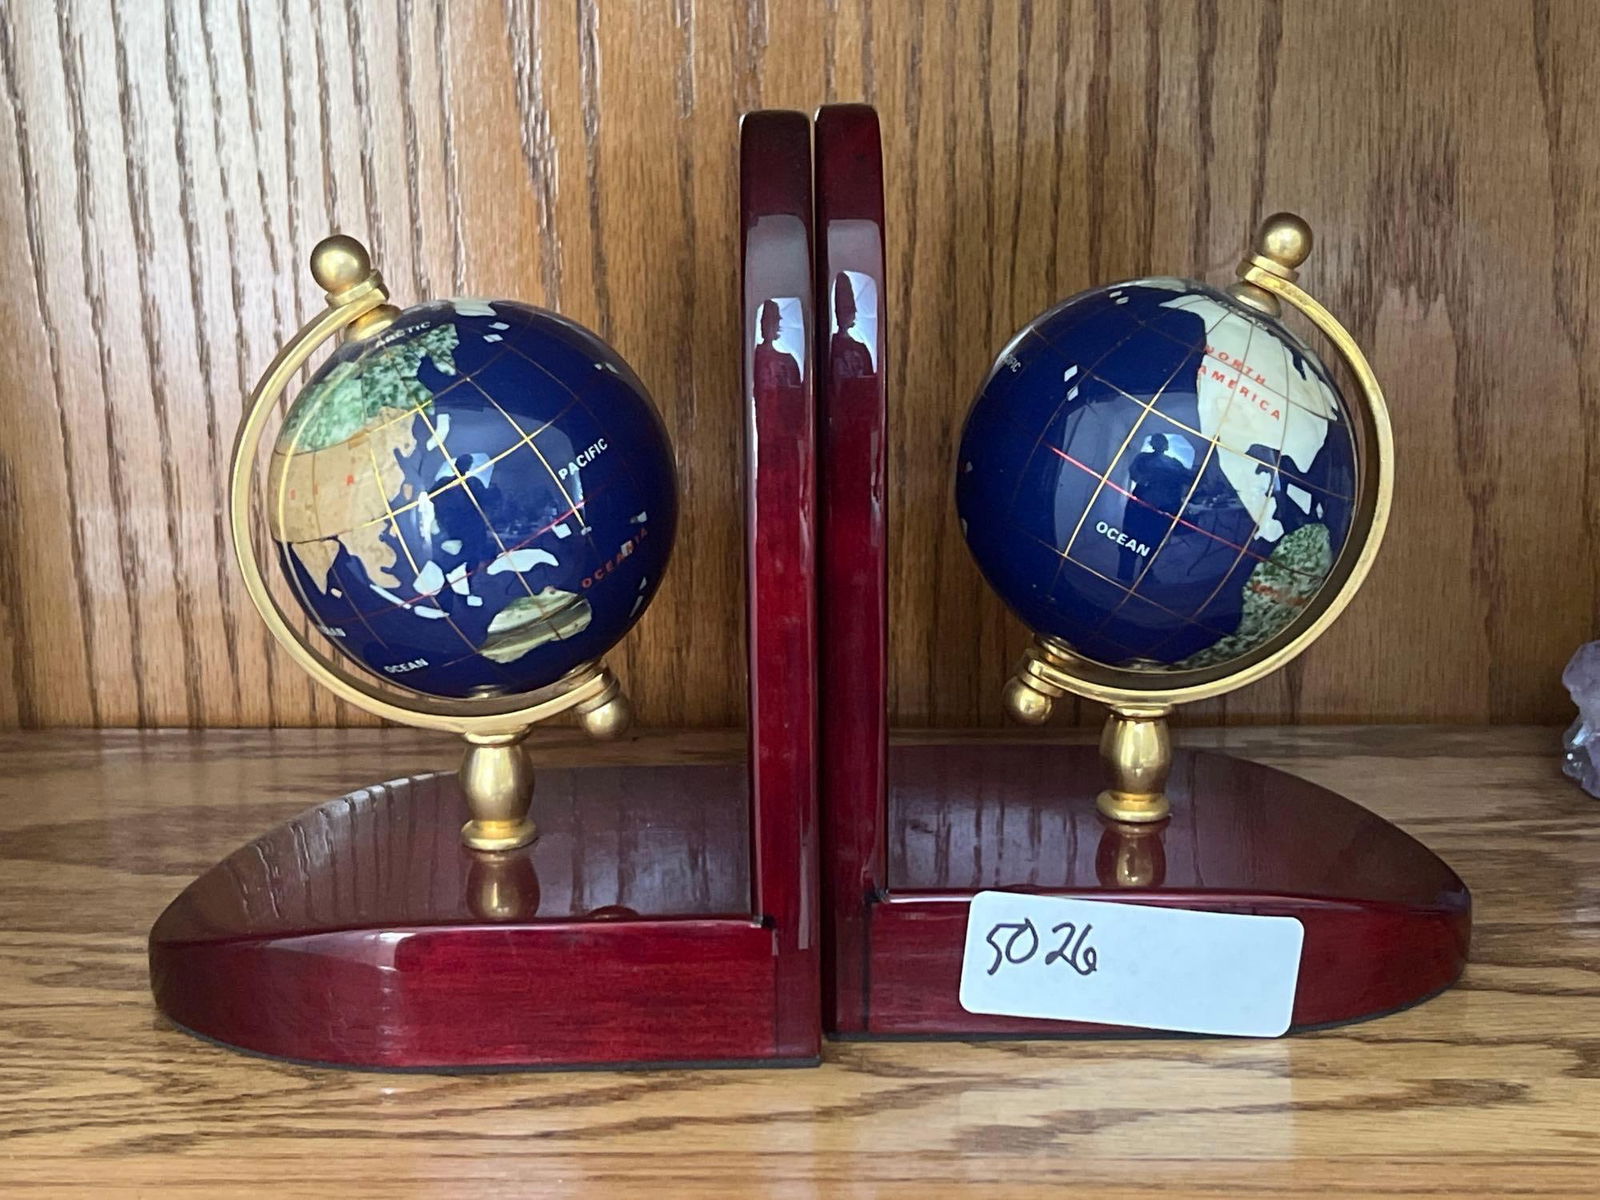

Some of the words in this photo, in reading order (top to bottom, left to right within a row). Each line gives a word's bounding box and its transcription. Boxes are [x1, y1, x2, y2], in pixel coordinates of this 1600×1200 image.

[1204, 344, 1266, 385] NORTH
[1197, 364, 1281, 420] AMERICA
[558, 438, 608, 480] PACIFIC
[581, 527, 647, 588] OCEANIA
[1095, 521, 1151, 557] OCEAN
[384, 658, 429, 674] OCEAN
